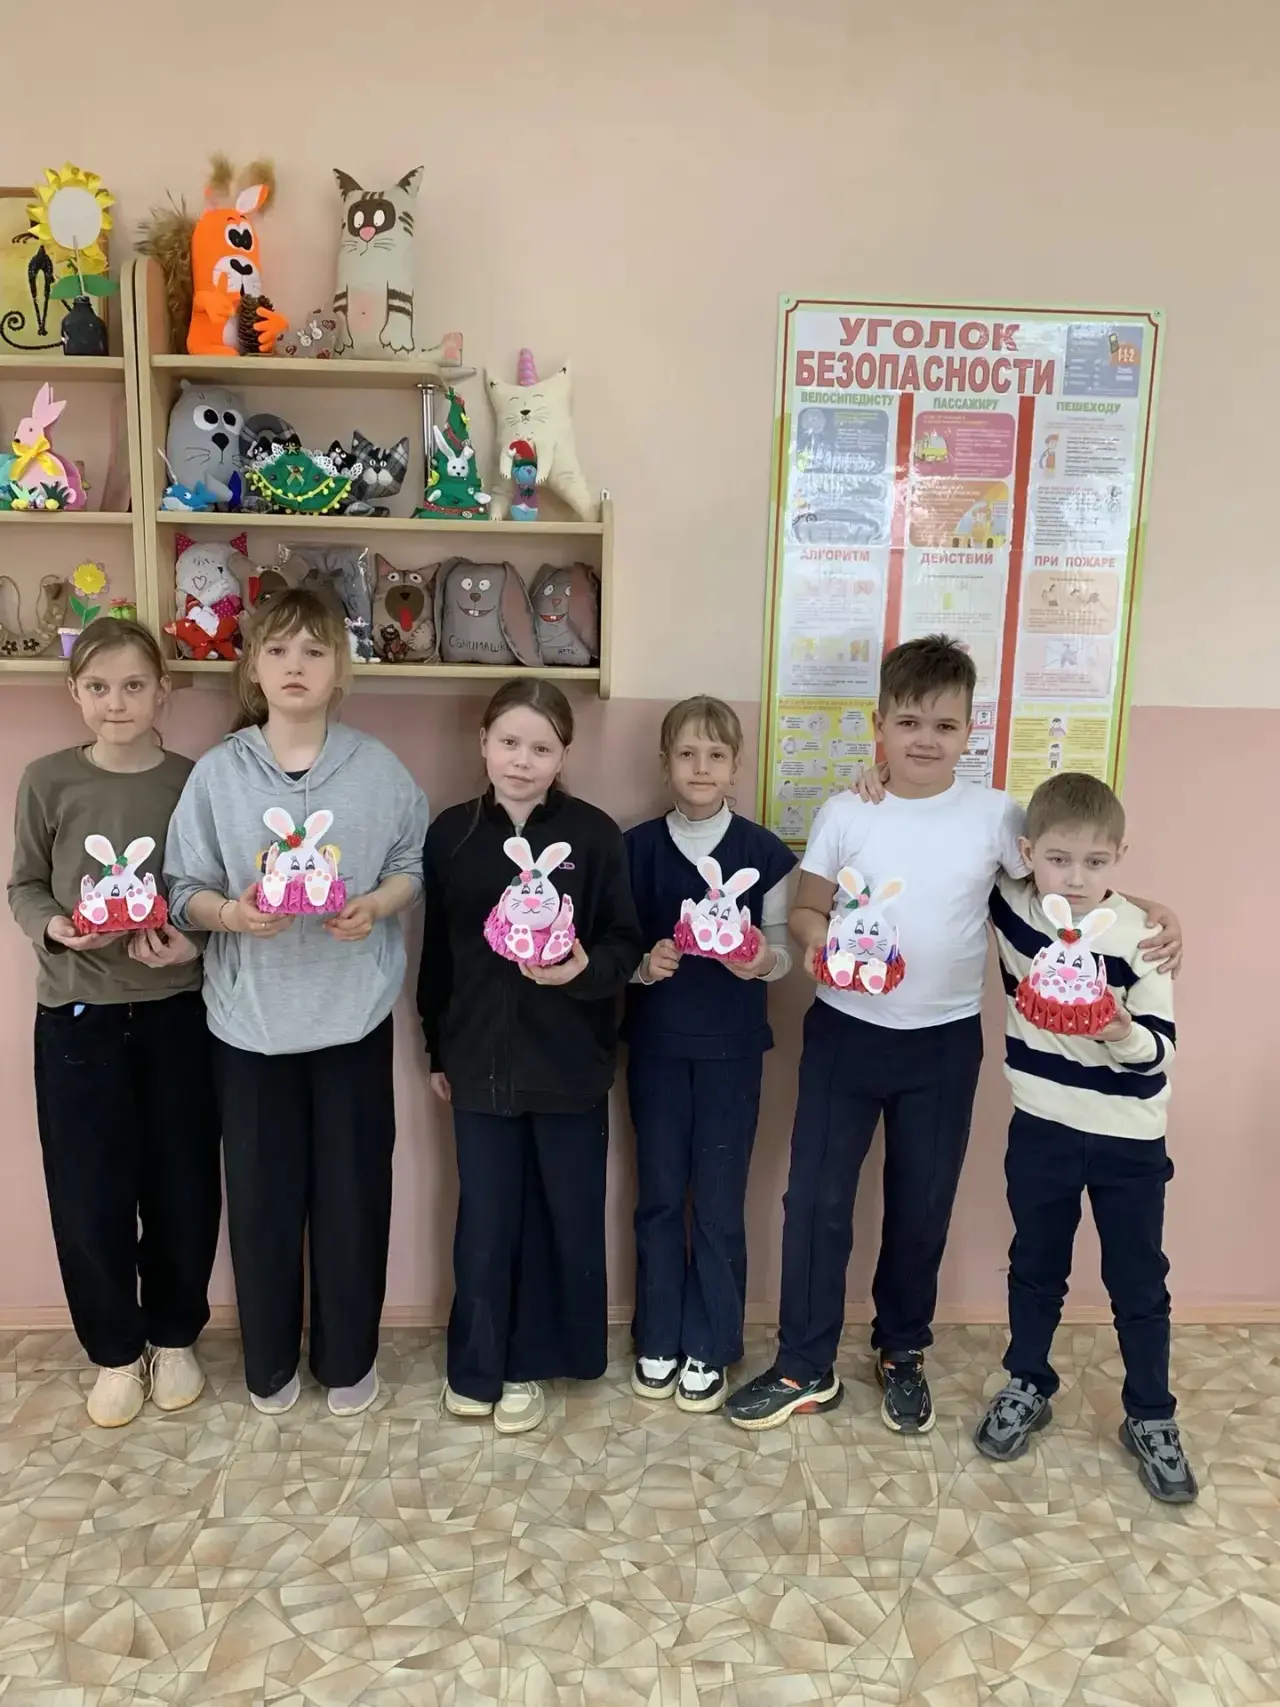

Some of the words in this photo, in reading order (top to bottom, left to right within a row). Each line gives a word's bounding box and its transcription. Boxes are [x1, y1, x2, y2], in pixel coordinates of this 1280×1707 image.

[839, 317, 1020, 351] УГОЛОК
[795, 351, 1055, 395] БЕЗОПАСНОСТИ
[800, 391, 895, 407] ВЕЛОСИПЕДИСТУ
[933, 397, 1000, 410] ПАССАЖИРУ
[1056, 401, 1121, 415] ПЕШЕХОДУ
[800, 549, 870, 562] АЛГОРИТМ
[920, 551, 994, 566] ДЕЙСТВИЙ
[1034, 555, 1059, 567] ПРИ
[1065, 556, 1117, 568] ПОЖАРЕ
